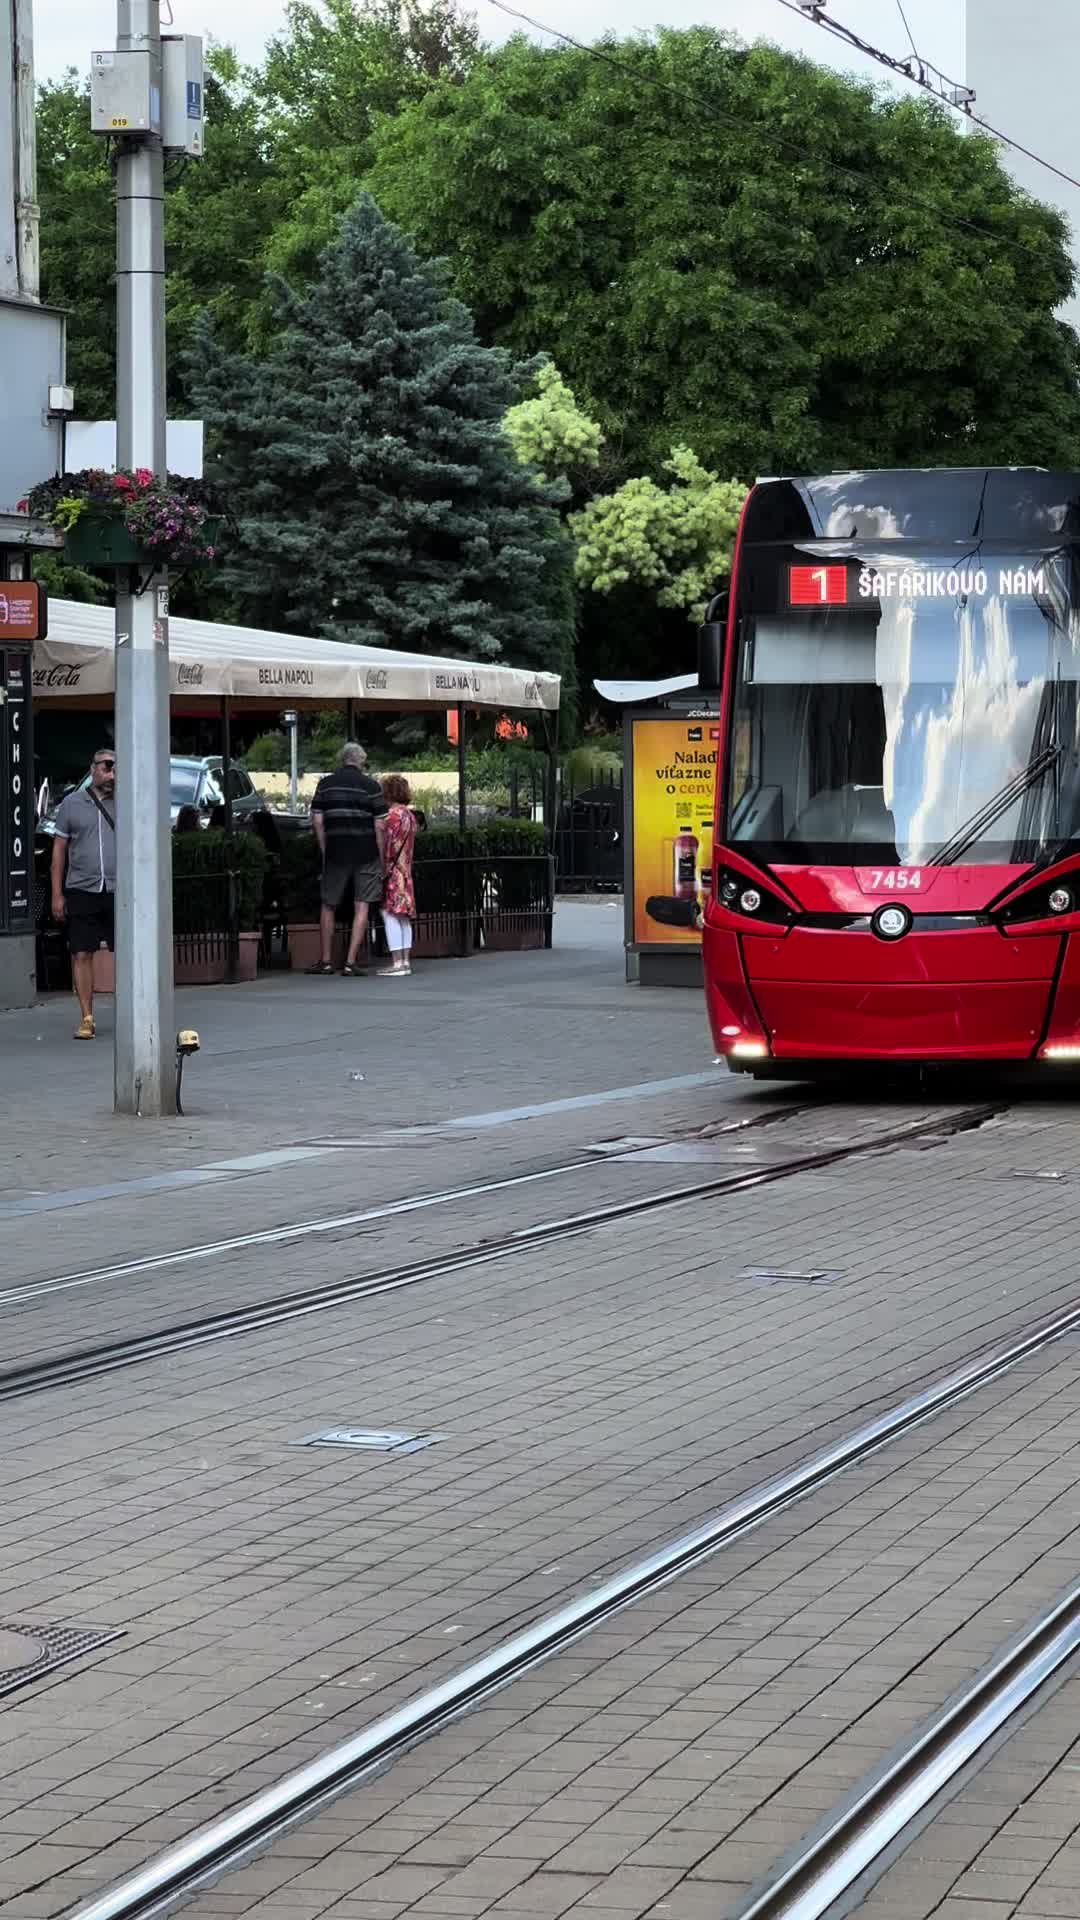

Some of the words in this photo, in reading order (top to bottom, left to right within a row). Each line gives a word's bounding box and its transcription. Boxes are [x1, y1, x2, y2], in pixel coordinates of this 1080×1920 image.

[811, 568, 828, 601] 1
[858, 567, 988, 597] ŠAFÁRIKOVO
[1000, 565, 1049, 596] NÁM.
[259, 669, 283, 685] BELLA
[285, 670, 314, 685] NAPOLI
[435, 675, 456, 689] BELLA
[457, 676, 481, 692] NALI
[656, 765, 711, 779] víťazne
[12, 711, 22, 857] CHOCO
[666, 784, 676, 794] o
[679, 784, 714, 798] ceny
[871, 870, 921, 889] 7454
